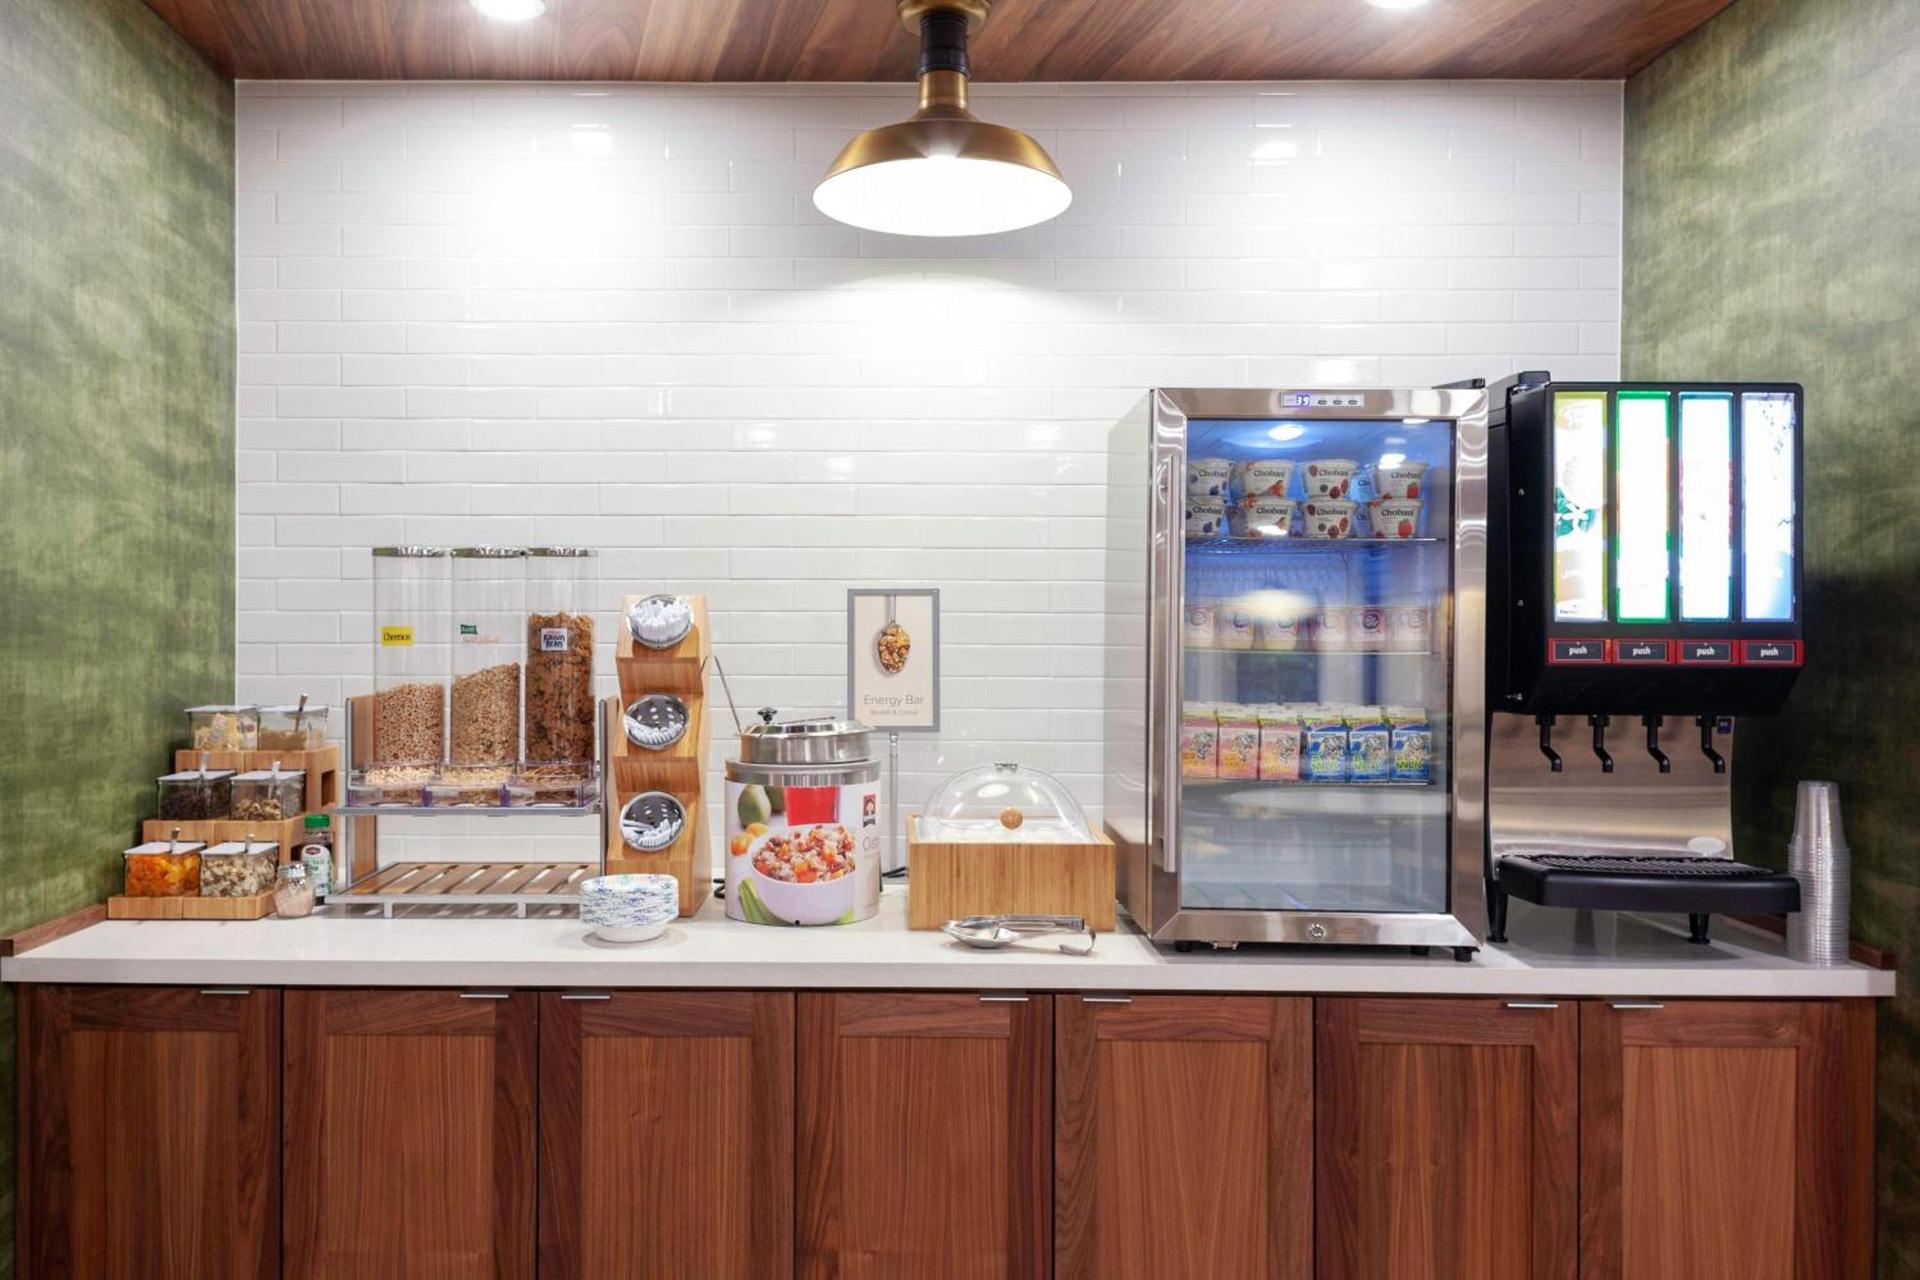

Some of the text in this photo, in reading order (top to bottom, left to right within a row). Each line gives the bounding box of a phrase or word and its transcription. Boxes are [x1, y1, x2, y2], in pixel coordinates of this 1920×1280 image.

[1296, 395, 1310, 406] 39
[1569, 646, 1588, 656] push
[1632, 646, 1651, 656] push
[1696, 647, 1715, 657] push
[1760, 647, 1779, 657] push
[864, 694, 925, 707] Energy Bar
